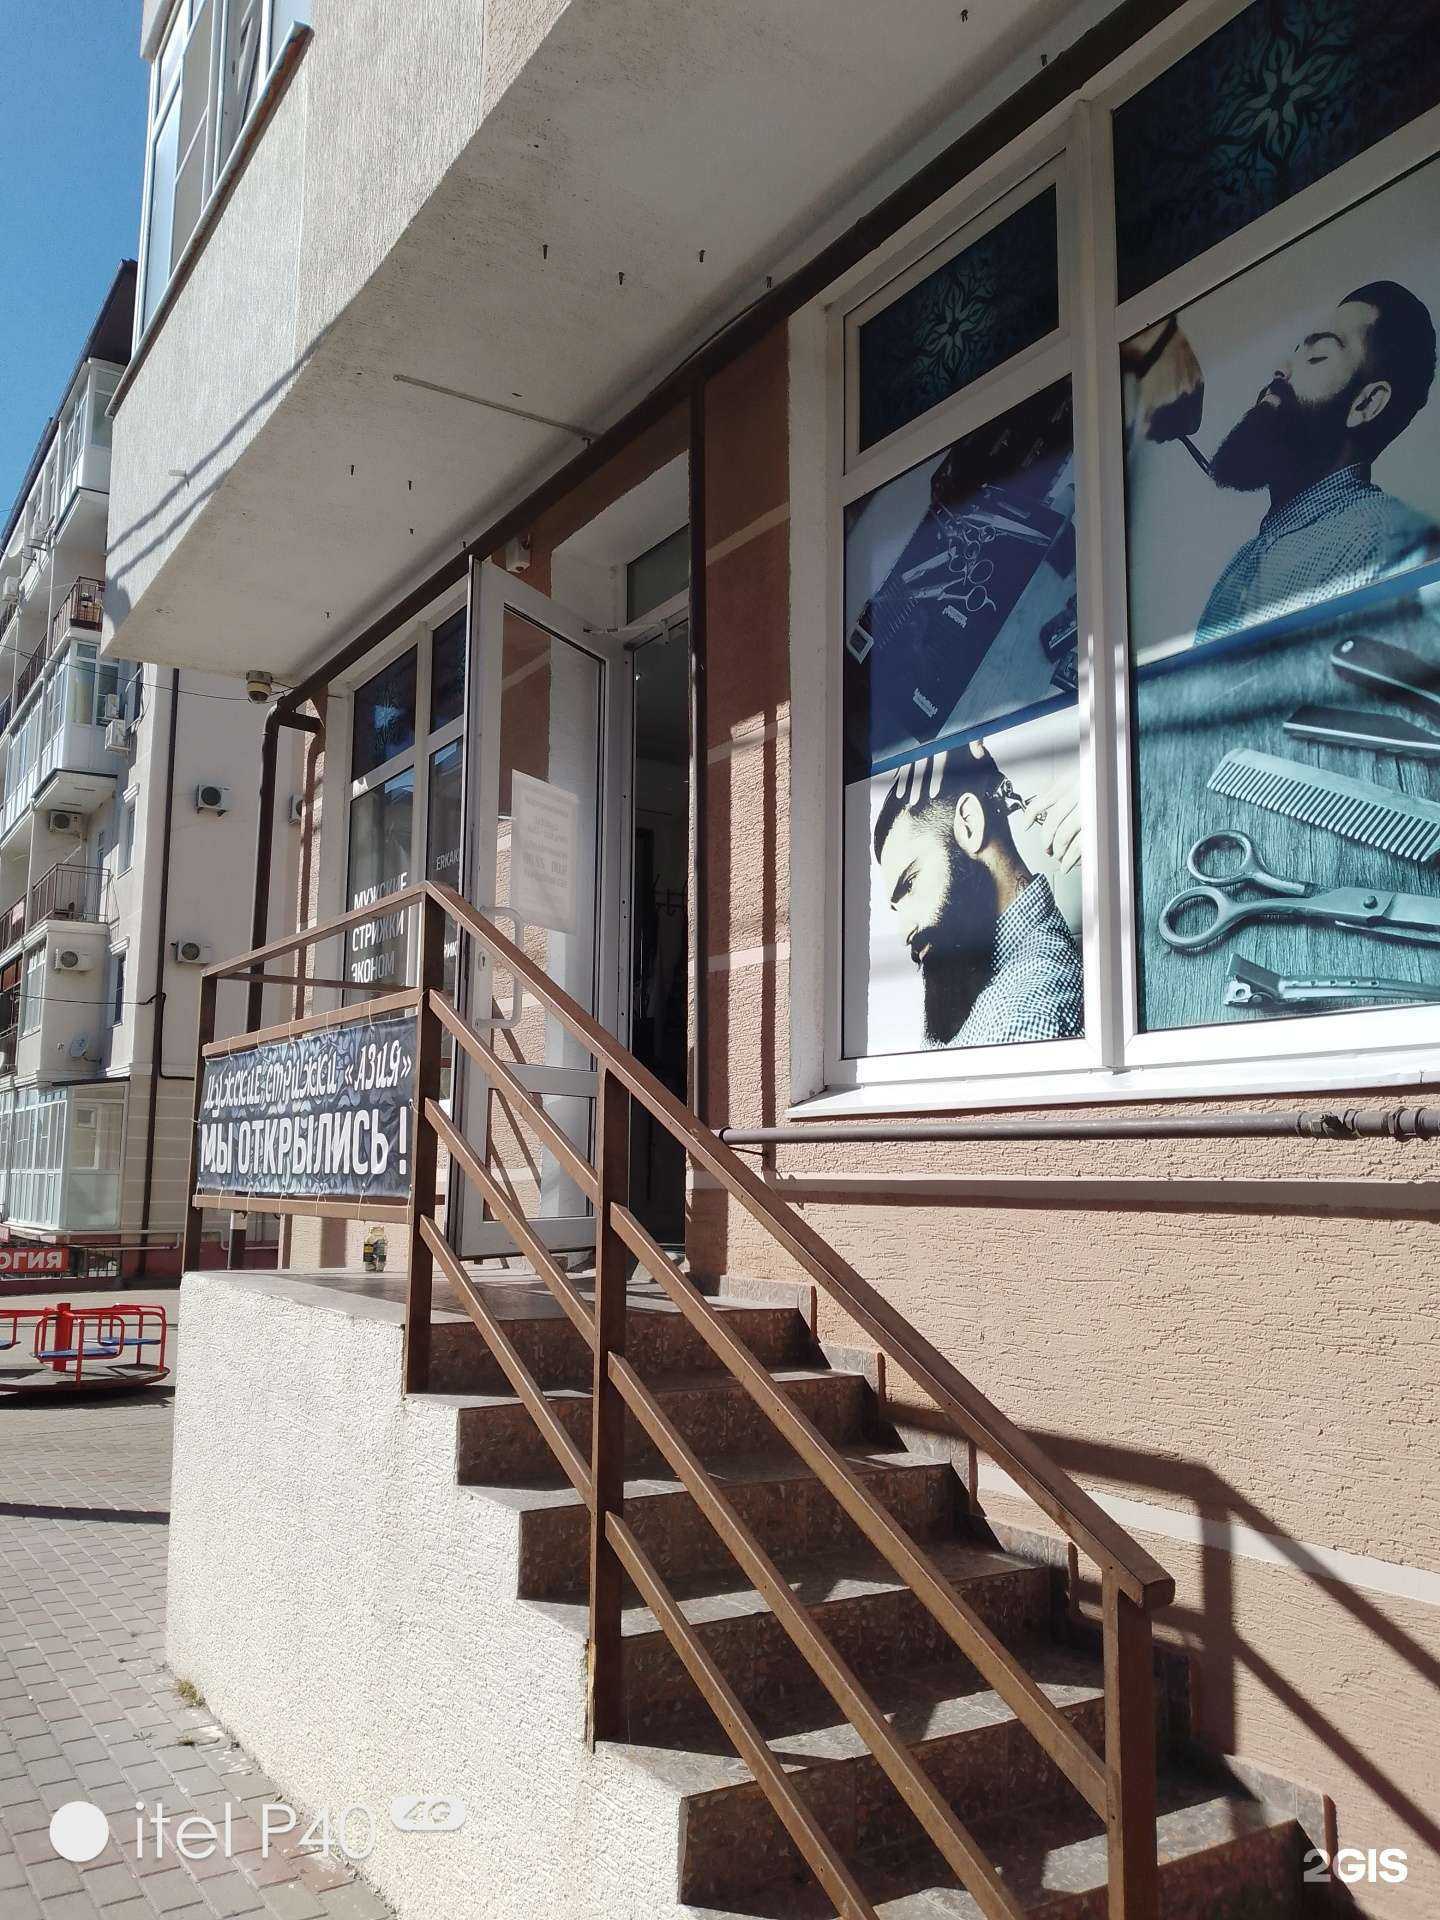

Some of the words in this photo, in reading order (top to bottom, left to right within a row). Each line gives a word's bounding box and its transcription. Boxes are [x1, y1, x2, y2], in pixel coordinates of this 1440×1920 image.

[352, 909, 404, 952] СТРИЖКИ
[351, 951, 395, 983] ЭКОНОМ
[201, 1123, 232, 1173] МЫ
